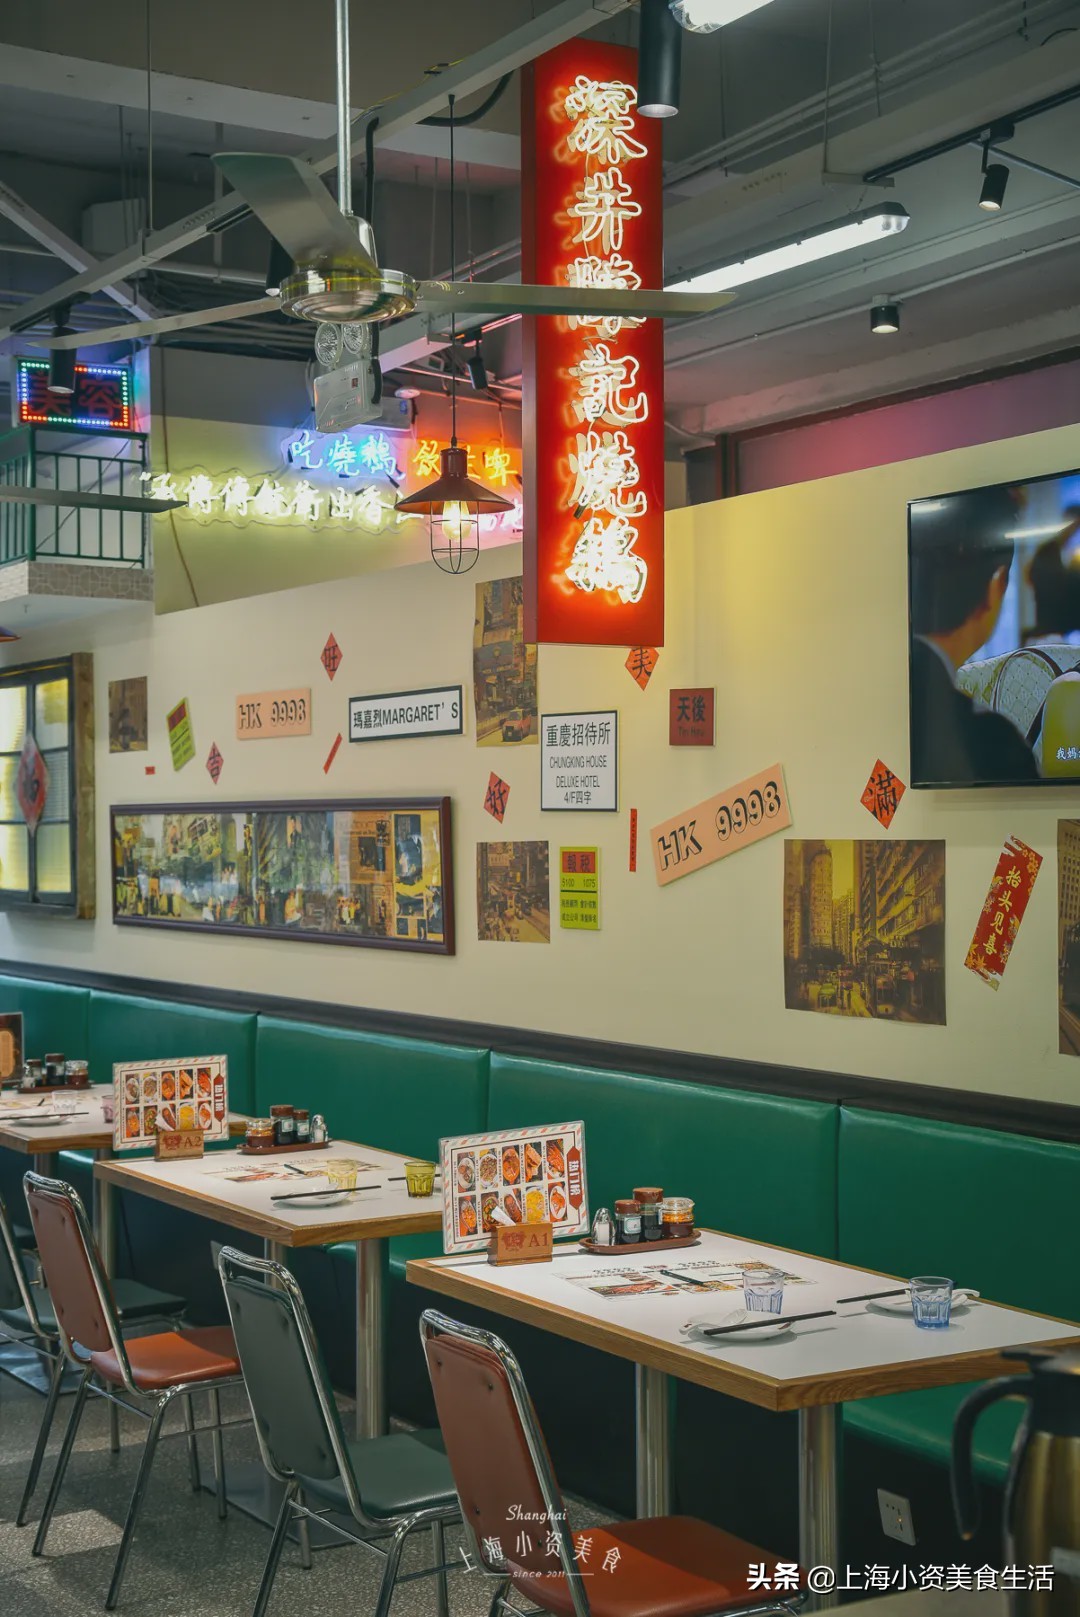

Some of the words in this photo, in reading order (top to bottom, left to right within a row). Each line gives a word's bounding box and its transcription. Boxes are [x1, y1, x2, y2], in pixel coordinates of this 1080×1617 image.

[238, 702, 262, 730] HK
[270, 698, 306, 726] 9998
[677, 695, 706, 723] 天後
[546, 721, 611, 748] 重慶招待所
[549, 756, 585, 769] CHUNGKING
[586, 755, 607, 768] HOUSE
[556, 776, 579, 788] DELUXE
[580, 775, 600, 788] HOTEL
[658, 819, 703, 872] HK
[715, 780, 781, 842] 9998
[982, 865, 1023, 956] 抬头见喜
[528, 1232, 549, 1248] A1
